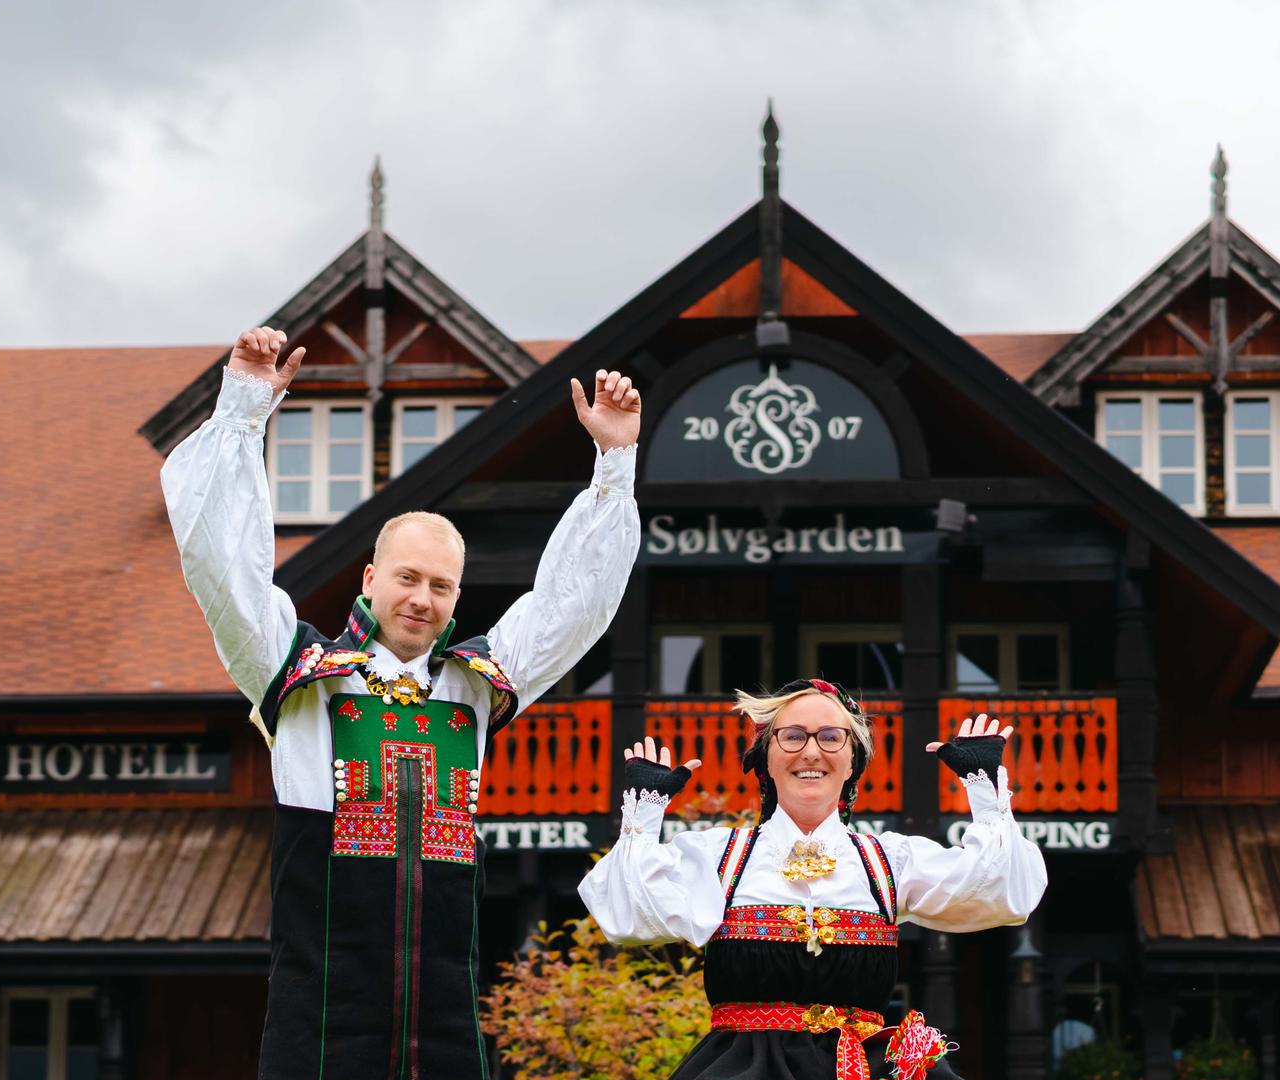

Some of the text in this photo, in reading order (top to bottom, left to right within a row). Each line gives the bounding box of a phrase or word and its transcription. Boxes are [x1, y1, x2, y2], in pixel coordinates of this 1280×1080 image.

[683, 416, 719, 440] 20
[827, 416, 863, 440] 07
[647, 513, 905, 564] Sølvgarden
[4, 743, 216, 782] HOTELL
[475, 821, 592, 849] YTTER
[946, 820, 1112, 849] CPING
